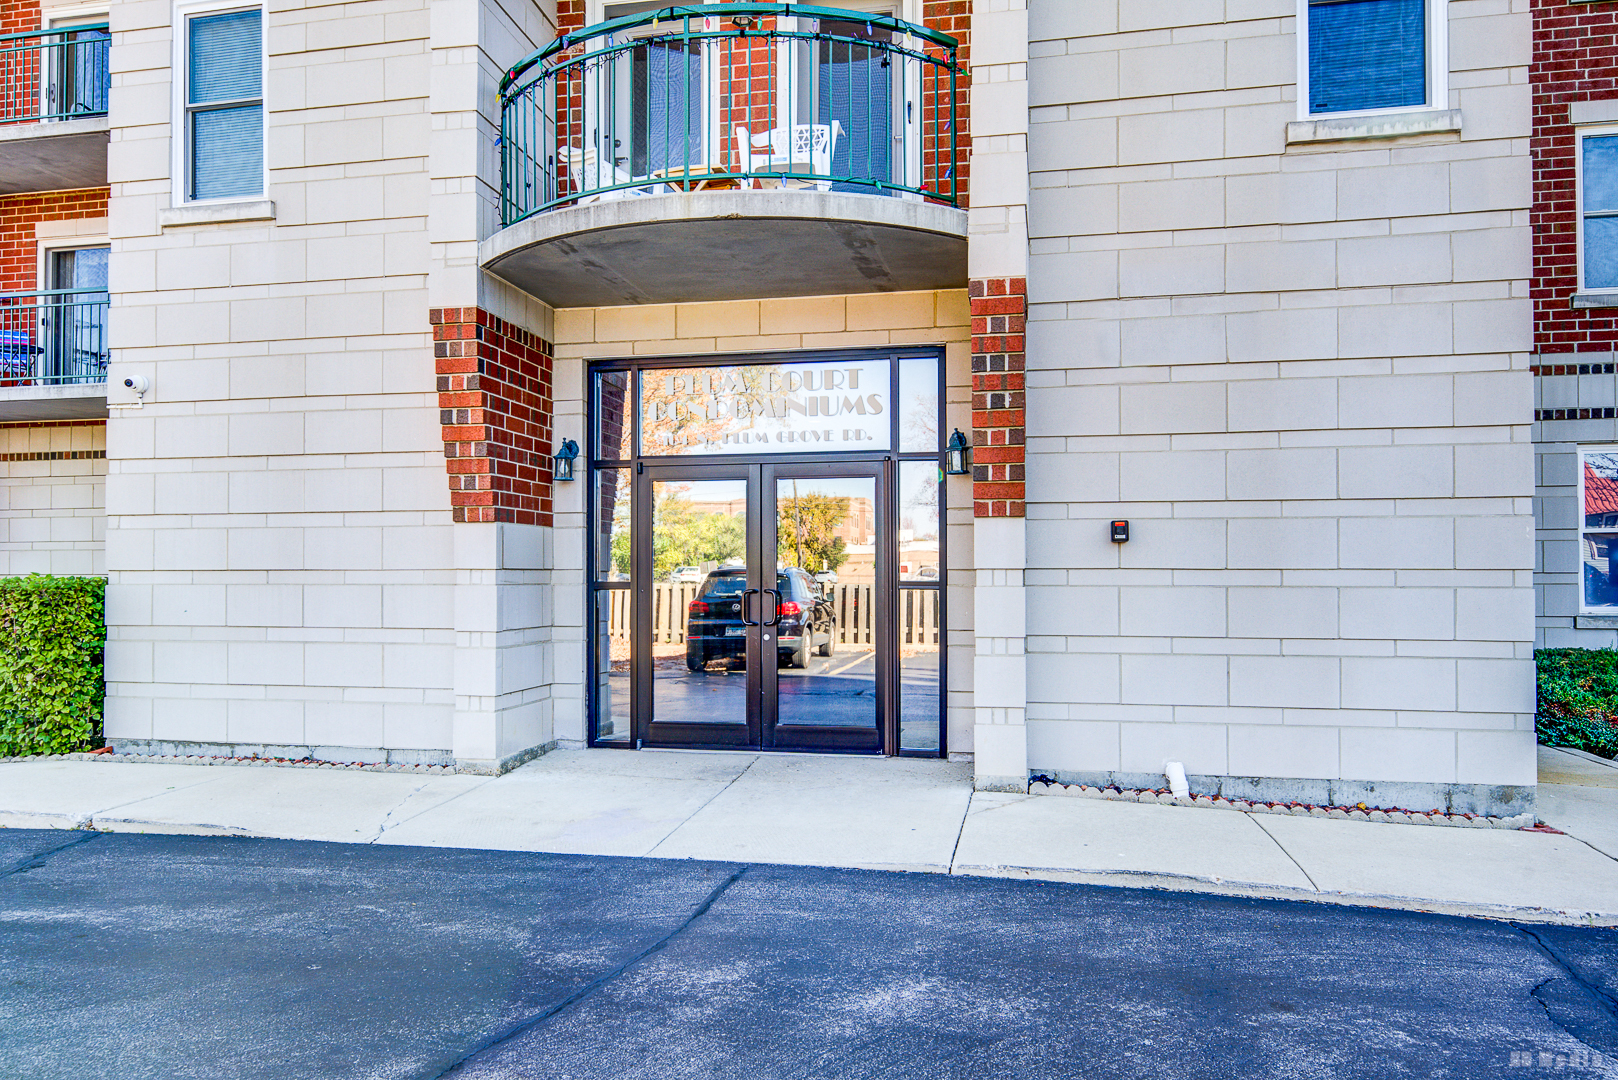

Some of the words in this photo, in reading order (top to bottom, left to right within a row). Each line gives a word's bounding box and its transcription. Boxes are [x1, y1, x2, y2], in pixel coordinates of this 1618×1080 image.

[665, 374, 748, 396] PLUM
[761, 368, 864, 392] COURT
[648, 393, 884, 421] CONDOMINIUMS
[776, 429, 834, 443] GROVE
[842, 428, 873, 442] RD.
